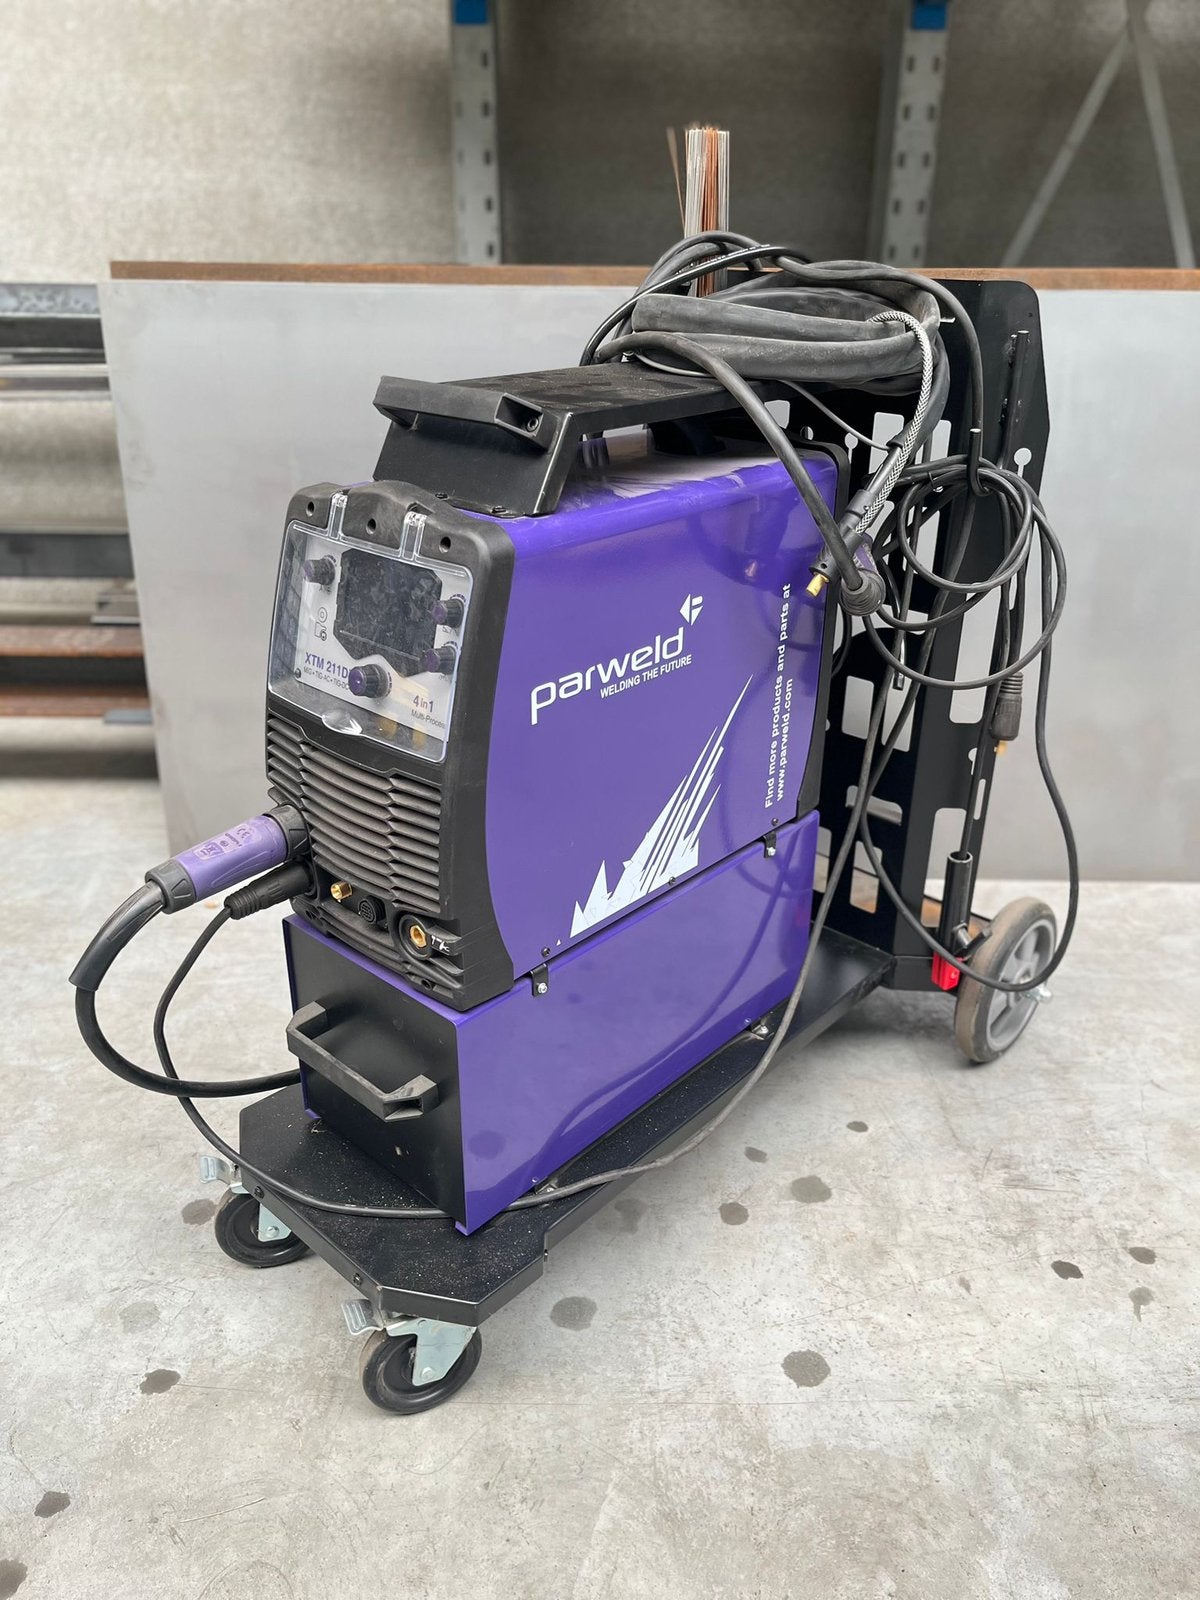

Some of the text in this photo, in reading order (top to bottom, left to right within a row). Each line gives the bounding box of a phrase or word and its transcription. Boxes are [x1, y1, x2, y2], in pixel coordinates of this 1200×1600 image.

[305, 652, 350, 679] XTM 211D
[531, 626, 684, 726] parweld
[600, 654, 692, 699] WELDING THE FUTURE
[413, 695, 434, 713] 4 in 1
[765, 583, 791, 808] Find more products and parts at
[411, 709, 447, 730] Multi-Proces
[777, 678, 793, 802] www.parweld.com
